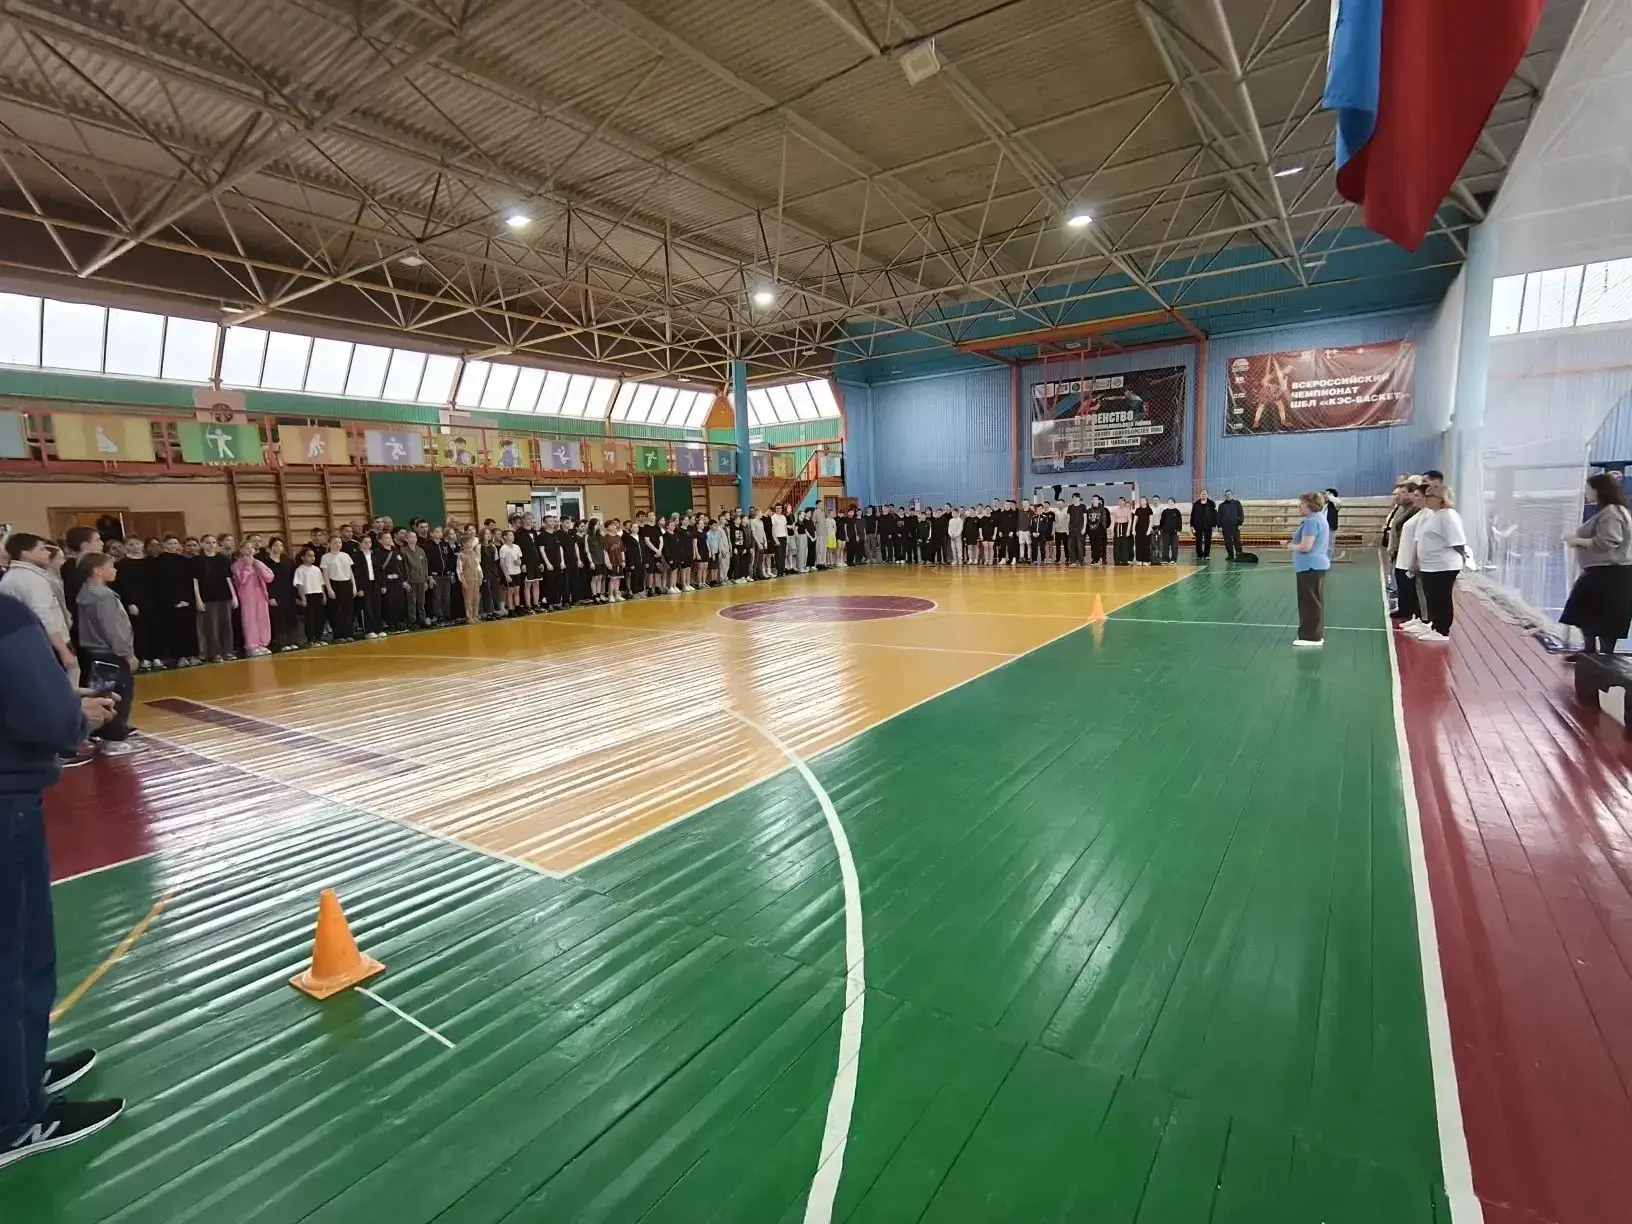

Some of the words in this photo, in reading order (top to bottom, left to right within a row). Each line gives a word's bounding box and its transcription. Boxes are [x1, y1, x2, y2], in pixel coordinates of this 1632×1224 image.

[1290, 386, 1360, 399] ЧЕМПИОНАТ
[1290, 399, 1317, 409] ШБЛ
[1074, 410, 1134, 425] ПРВЕНСТВО
